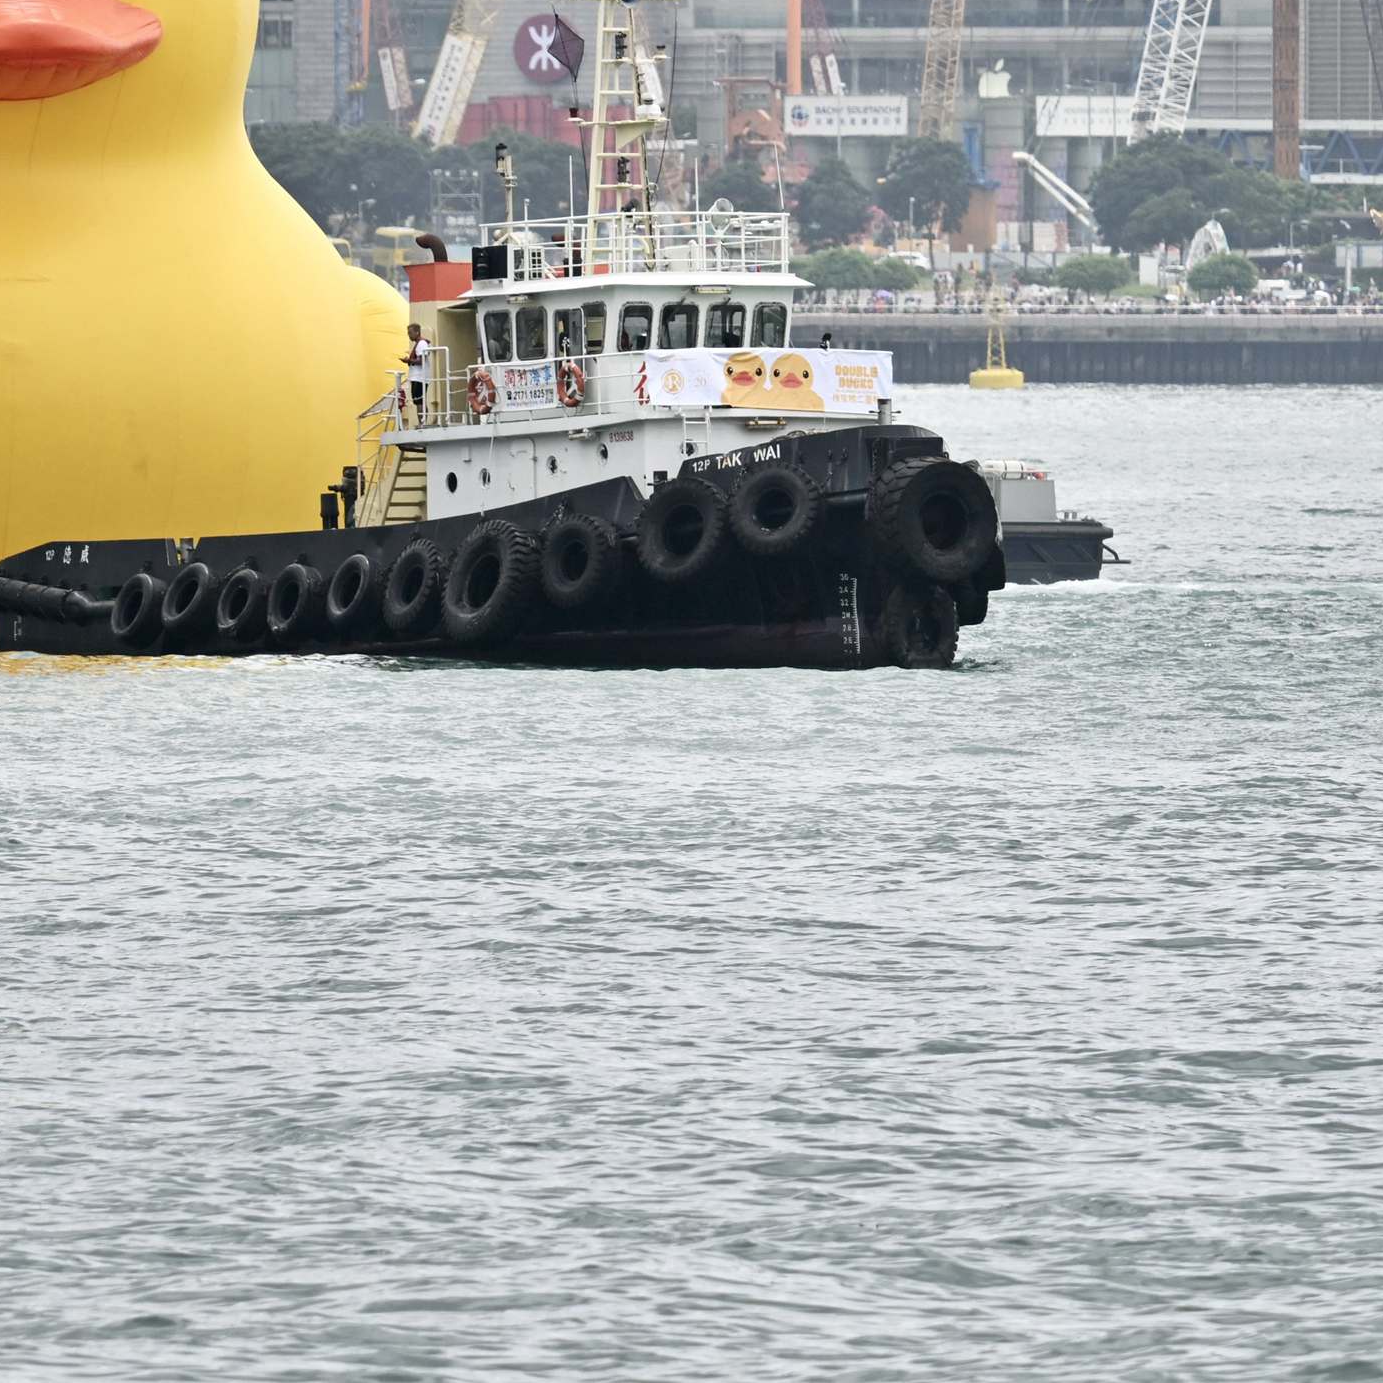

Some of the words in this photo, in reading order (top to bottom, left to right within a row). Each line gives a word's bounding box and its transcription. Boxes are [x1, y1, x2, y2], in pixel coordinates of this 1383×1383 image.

[513, 390, 528, 400] 2771
[530, 388, 545, 398] 1825
[692, 459, 711, 473] 12P
[716, 452, 742, 470] TAK
[753, 444, 781, 462] WAI
